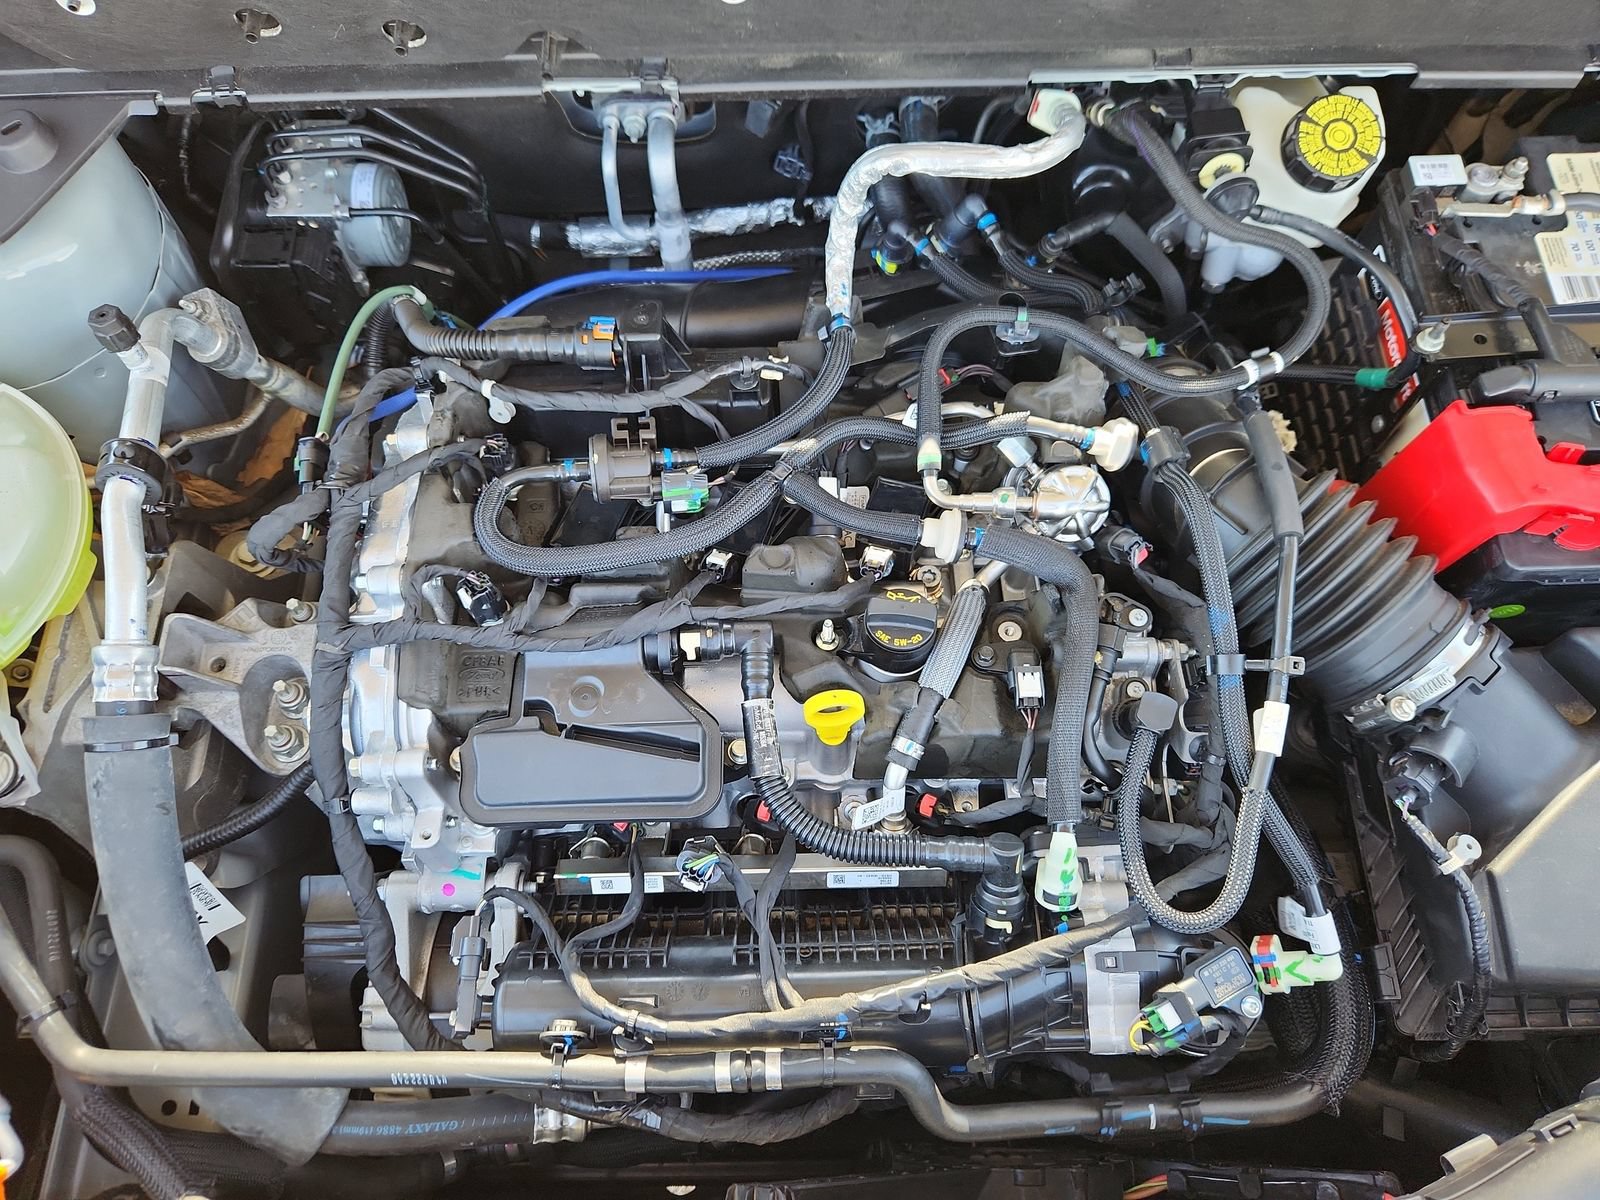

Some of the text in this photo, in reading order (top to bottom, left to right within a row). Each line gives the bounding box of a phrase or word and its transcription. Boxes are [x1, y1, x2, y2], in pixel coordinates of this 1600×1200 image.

[875, 630, 923, 647] SAE 5W-20
[376, 1124, 403, 1136] 4886
[404, 1119, 459, 1136] GALAXY
